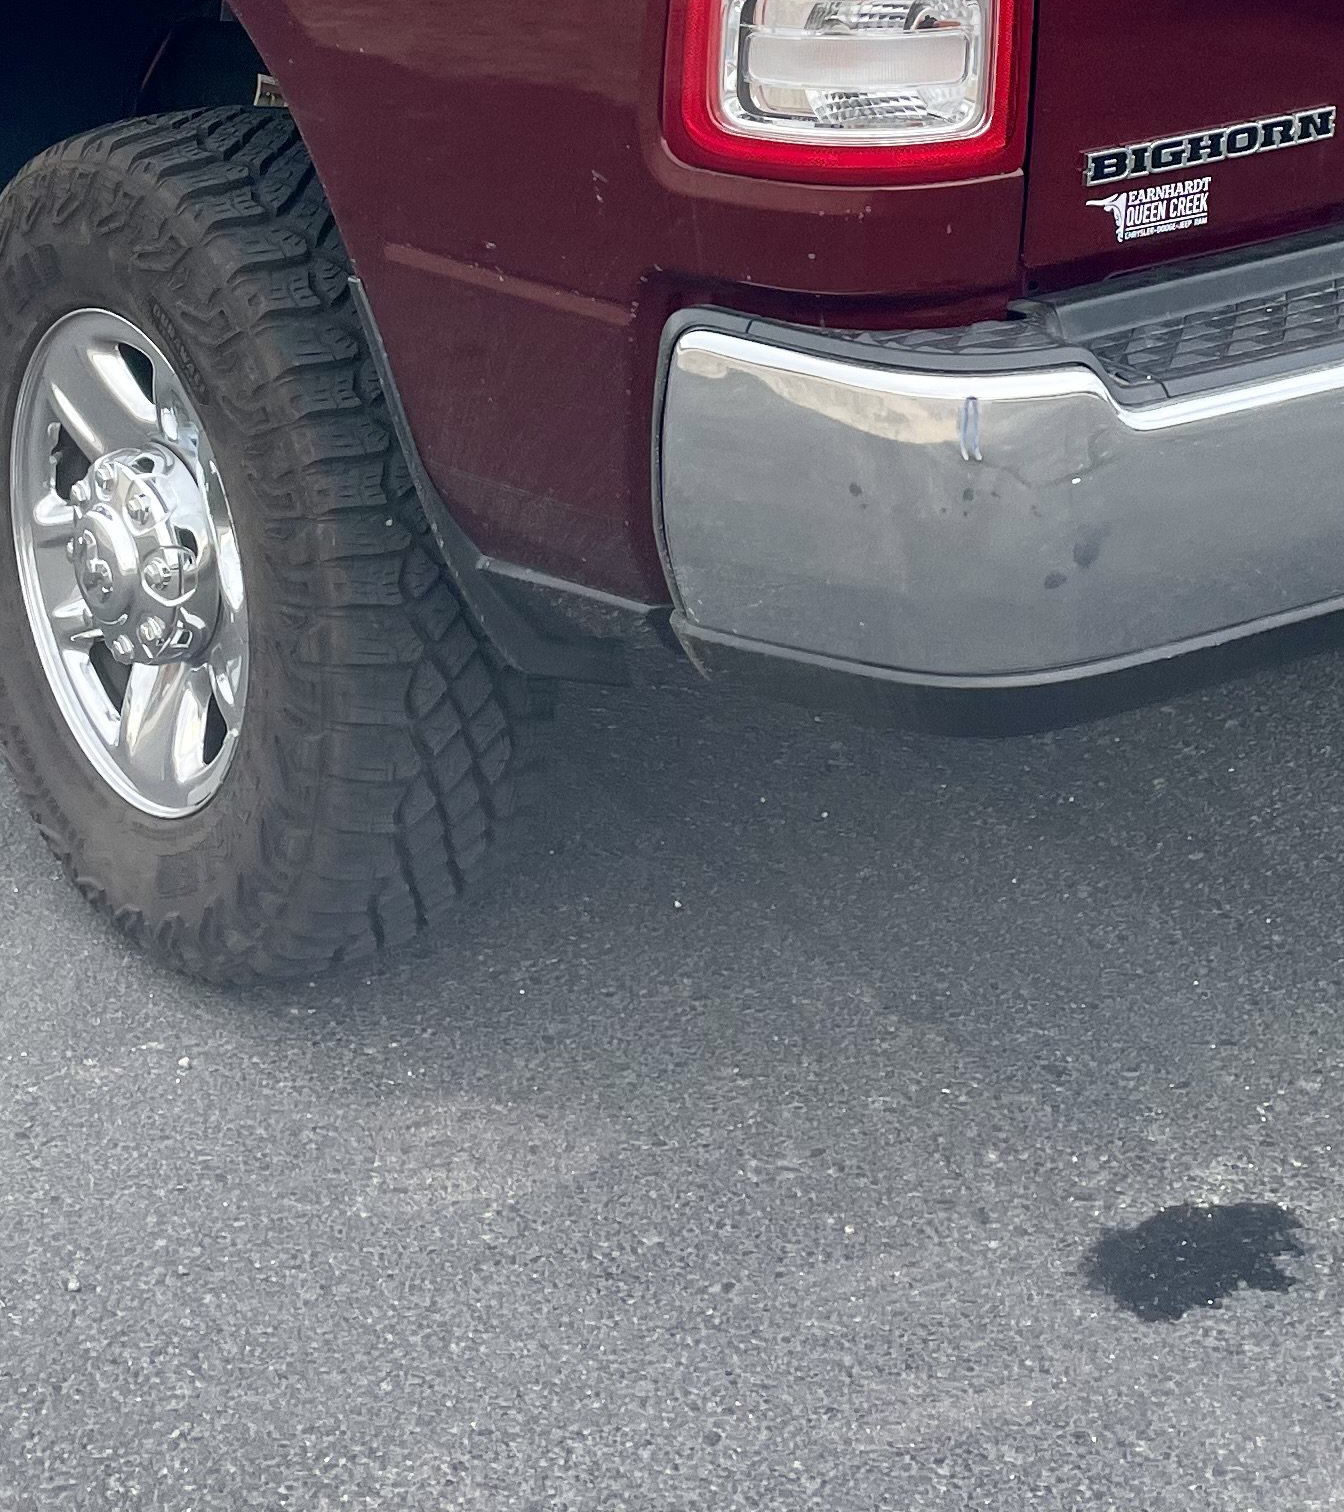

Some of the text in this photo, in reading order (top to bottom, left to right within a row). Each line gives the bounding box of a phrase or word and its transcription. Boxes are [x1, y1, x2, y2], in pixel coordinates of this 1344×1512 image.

[1086, 105, 1336, 186] BIGHORN
[1128, 176, 1212, 206] EARNHARDT
[1126, 192, 1209, 227] QUEEN CREEK
